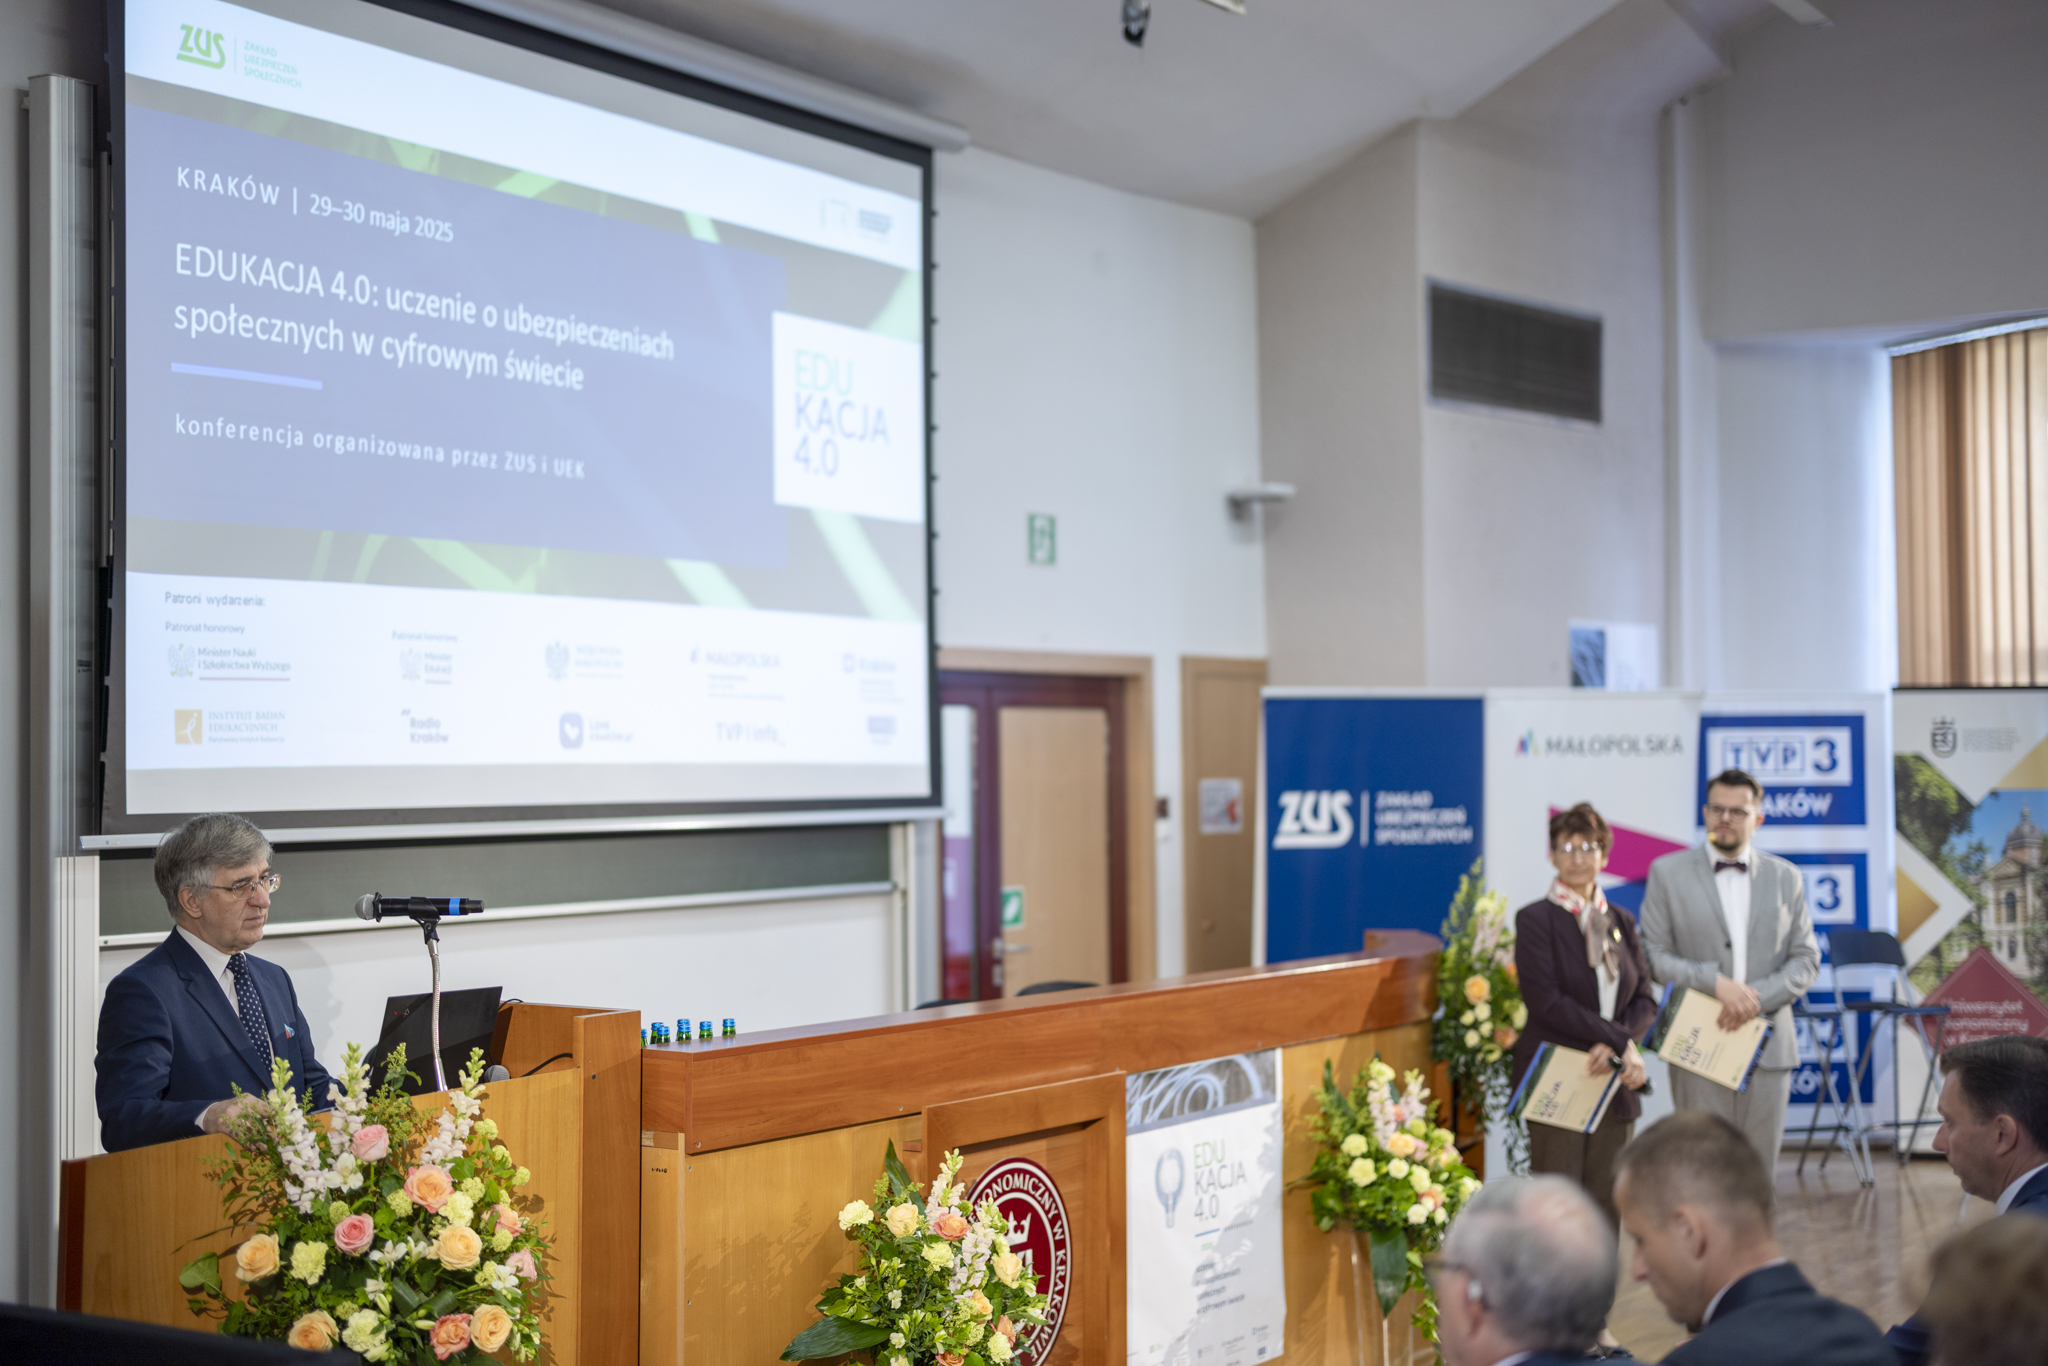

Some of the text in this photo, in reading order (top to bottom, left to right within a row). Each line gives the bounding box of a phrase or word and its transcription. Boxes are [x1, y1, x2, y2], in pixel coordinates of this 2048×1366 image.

[176, 24, 226, 69] ZUS
[177, 166, 280, 206] KRAKÓW
[370, 208, 410, 236] maja
[414, 215, 454, 242] 2025
[176, 243, 675, 361] EDUKACJA 4.0: uczenie o ubezpieczeniach
[173, 303, 584, 390] społecznych w cyfrowym świecie
[795, 348, 853, 397] EDU
[794, 391, 890, 446] KACJA
[175, 413, 304, 449] konferencja
[313, 430, 445, 465] organizowana
[451, 447, 498, 470] przez
[503, 451, 537, 475] ZUS
[553, 457, 586, 480] UEK
[794, 435, 839, 477] 4.0
[165, 591, 266, 608] Patroni wydarzenia:
[165, 621, 246, 635] Patronat honorowy
[197, 647, 257, 658] Minister Nauki
[202, 660, 250, 672] Szkolnictwa
[208, 711, 252, 721] INSTYTUT
[1545, 734, 1684, 757] MAŁOPOLSKA
[1731, 737, 1839, 774] TVP 3
[1273, 790, 1354, 850] ZUS
[1761, 788, 1833, 818] AKÓW
[1815, 876, 1842, 911] 3
[1944, 1017, 2030, 1033] konomiczny
[1194, 1139, 1226, 1170] EDU
[1194, 1160, 1248, 1198] KACJA
[1193, 1194, 1221, 1222] 4.0
[1052, 1220, 1065, 1241] W
